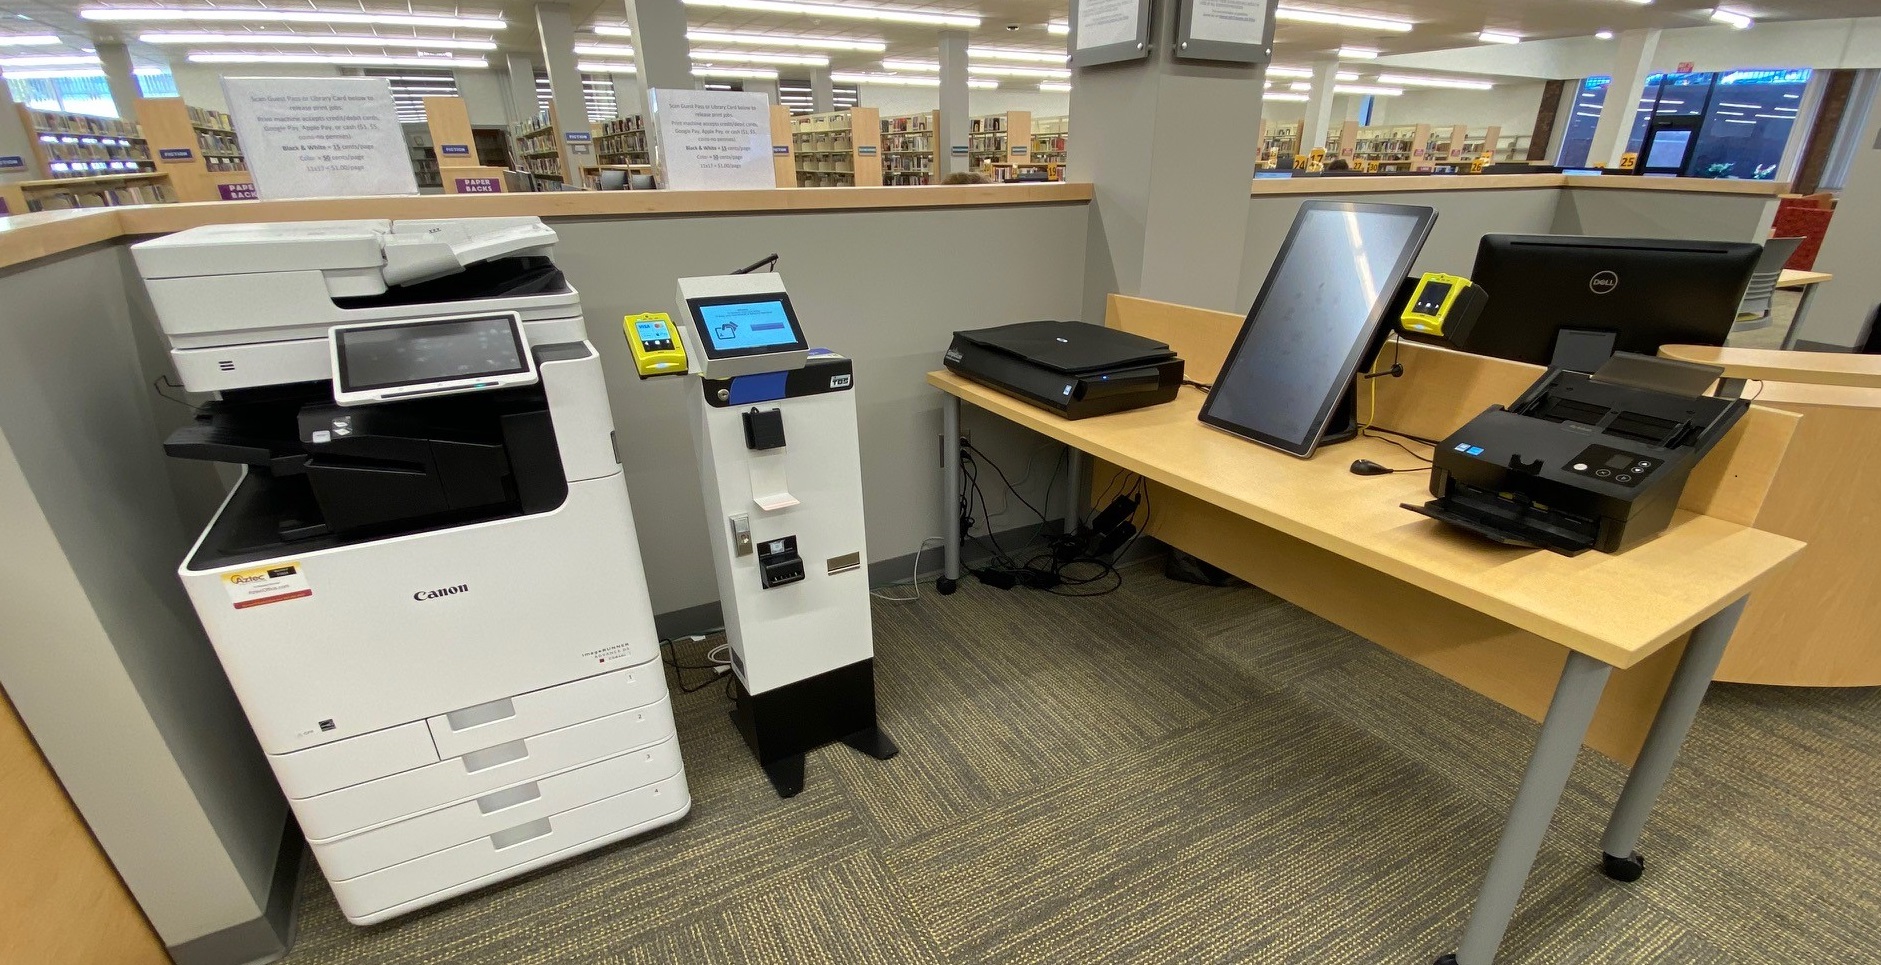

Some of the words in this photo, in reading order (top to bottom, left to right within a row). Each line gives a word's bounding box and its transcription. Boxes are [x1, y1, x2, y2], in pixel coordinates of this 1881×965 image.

[1312, 154, 1324, 164] 17
[1621, 158, 1634, 166] 25
[1048, 168, 1056, 176] 19
[1472, 164, 1481, 172] 26
[233, 574, 266, 584] Aztec
[414, 584, 468, 601] Canon
